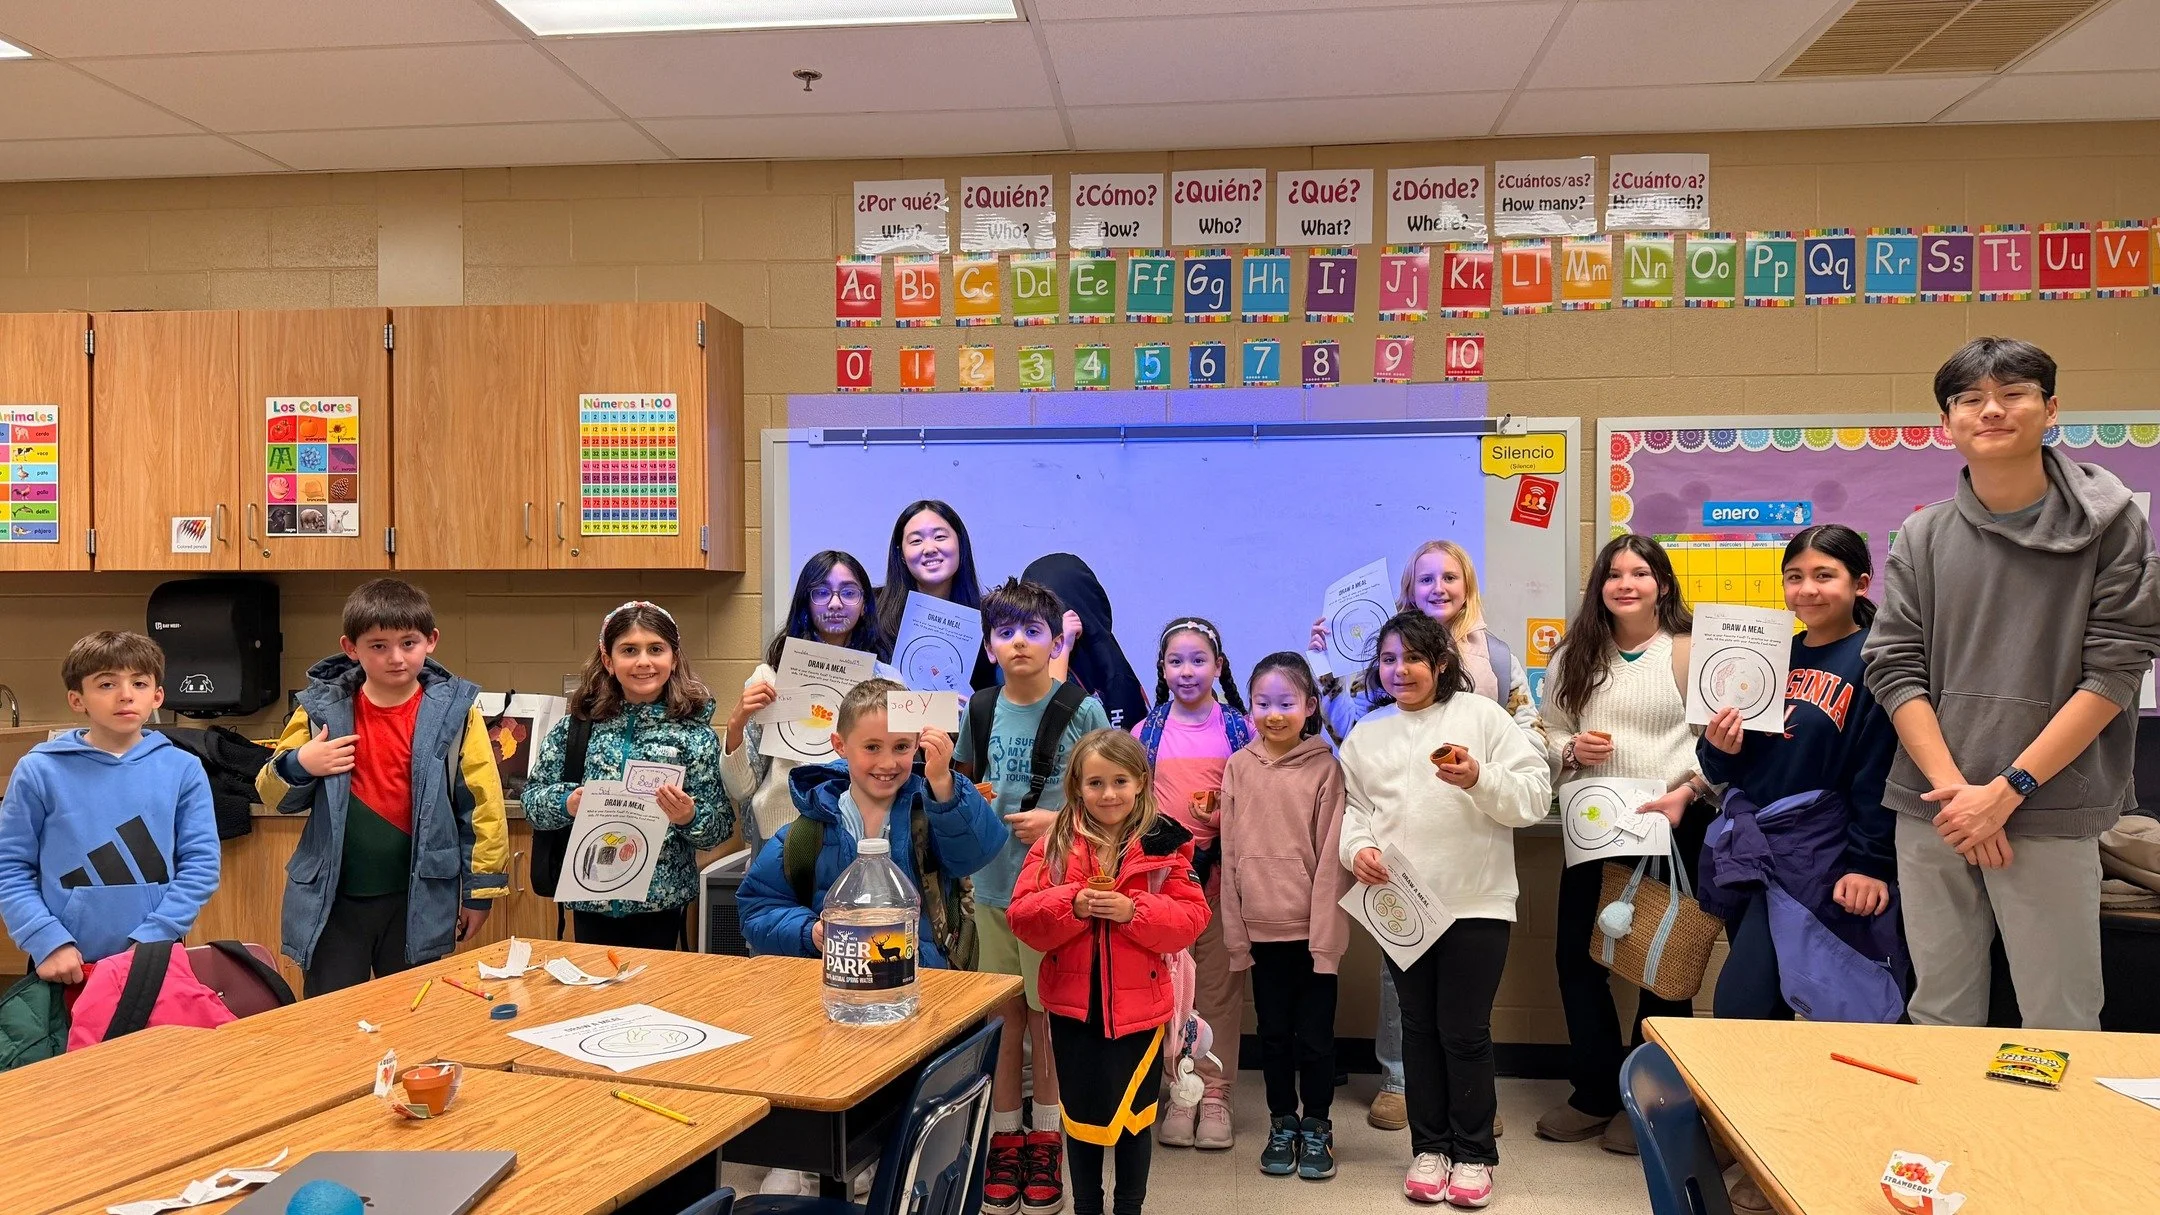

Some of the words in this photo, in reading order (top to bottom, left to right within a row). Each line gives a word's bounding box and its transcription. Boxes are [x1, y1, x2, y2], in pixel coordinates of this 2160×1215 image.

[1174, 178, 1262, 204] ¿Quién?
[1288, 178, 1360, 205] ¿Qué?
[1392, 178, 1480, 202] ¿Dónde?
[1498, 172, 1591, 190] ¿Cuántos/as?
[1612, 171, 1705, 189] ¿Cuánto/a?
[858, 195, 896, 212] ¿Por
[902, 192, 941, 211] qué?
[964, 185, 1049, 209] ¿Quién?
[1076, 184, 1158, 206] ¿Cómo?
[1502, 197, 1534, 212] How
[1540, 196, 1586, 212] many?
[1613, 195, 1648, 209] How
[882, 224, 922, 240] Why?
[988, 223, 1030, 240] Who?
[1098, 221, 1140, 238] How?
[1199, 218, 1242, 234] Who?
[1301, 219, 1351, 236] What?
[1407, 214, 1468, 232] Where?
[1630, 246, 1667, 279] Nn
[1692, 246, 1730, 279] Oo
[1875, 242, 1911, 276] Rr
[1928, 240, 1965, 273] Ss
[1984, 238, 2023, 272] Tt
[2046, 238, 2084, 271] Uu
[2104, 235, 2140, 268] Vv
[1132, 263, 1170, 296] Ff
[1249, 263, 1284, 294] Hh
[1318, 262, 1345, 294] Ii
[1450, 258, 1485, 290] Kk
[1512, 254, 1541, 286] Ll
[1565, 250, 1608, 282] Mm
[1754, 244, 1789, 293] Pp
[1808, 242, 1852, 290] Qq
[840, 267, 877, 302] Aa
[901, 269, 936, 302] Bb
[960, 268, 994, 298] Cc
[1016, 268, 1051, 298] Dd
[1076, 266, 1109, 296] Ee
[1186, 264, 1224, 309] Gg
[1386, 260, 1418, 308] Jj
[846, 352, 864, 380] 0
[914, 354, 920, 380] 1
[970, 352, 985, 380] 2
[1030, 352, 1046, 381] 3
[1084, 350, 1101, 378] 4
[1144, 350, 1160, 380] 5
[1200, 349, 1216, 378] 6
[1253, 346, 1272, 375] 7
[1313, 348, 1330, 376] 8
[1385, 342, 1403, 372] 9
[1452, 339, 1479, 368] 10
[274, 401, 295, 412] Los
[300, 401, 352, 412] Colores
[584, 398, 636, 409] Números
[641, 398, 671, 408] 1-100
[1492, 446, 1554, 460] Silencio
[1712, 508, 1760, 520] enero
[1724, 580, 1732, 590] 8
[1754, 580, 1762, 594] 9
[1722, 623, 1741, 632] DRAW
[1748, 626, 1765, 634] MEAL
[808, 660, 825, 669] DRAW
[831, 665, 846, 674] MEAL
[1785, 668, 1854, 733] GINIA
[1008, 748, 1026, 756] MY
[1006, 774, 1060, 784] TOURNENT
[604, 798, 621, 806] DRAW
[628, 801, 645, 811] MEAL
[1401, 872, 1415, 890] DRAW
[1417, 893, 1430, 908] MEAL
[826, 938, 871, 958] DEER
[826, 954, 873, 977] PARK
[1884, 1175, 1934, 1194] STRAWBERRY
